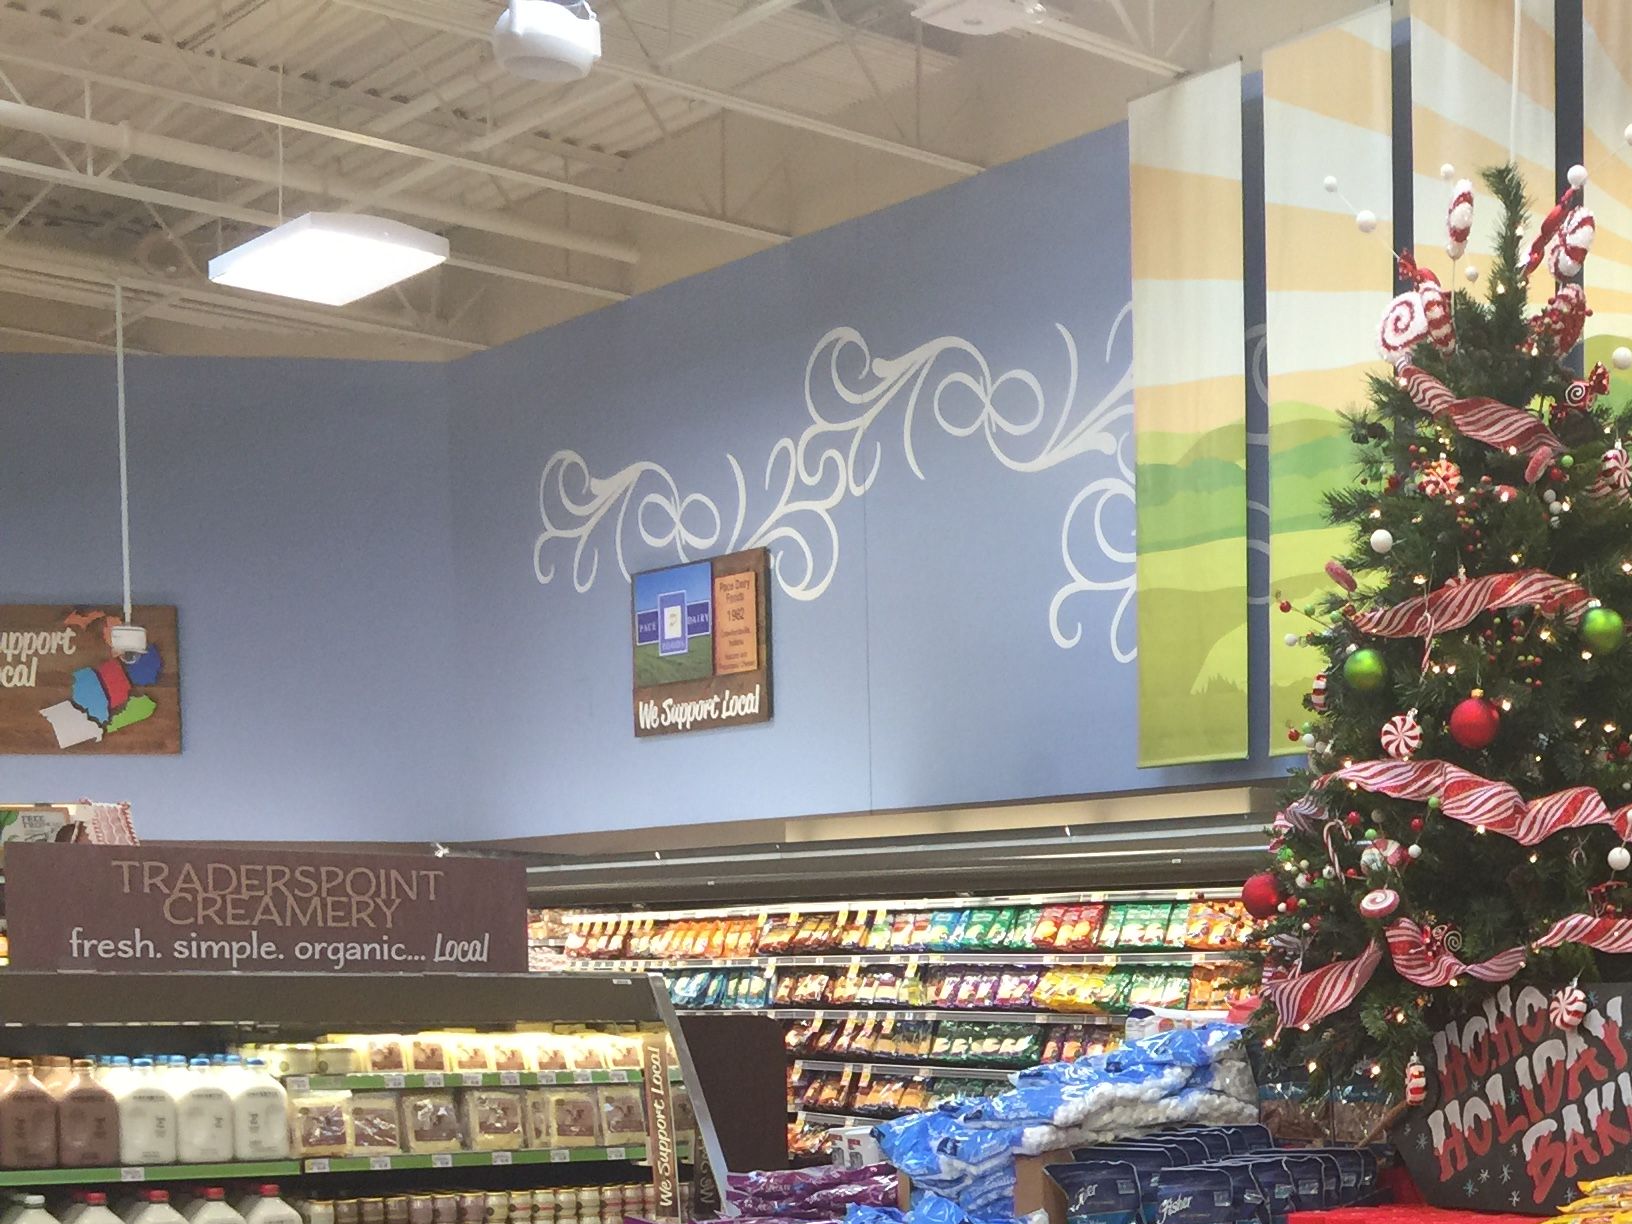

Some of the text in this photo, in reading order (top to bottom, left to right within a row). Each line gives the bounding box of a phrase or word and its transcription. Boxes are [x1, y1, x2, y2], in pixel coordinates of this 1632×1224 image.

[0, 656, 38, 688] cal
[639, 684, 760, 730] We Support Local
[111, 859, 445, 901] TRADERSPOINT
[162, 892, 402, 928] CREAMERY
[69, 927, 162, 960] fresh.
[173, 930, 284, 970] simple.
[432, 932, 490, 963] Local
[1427, 995, 1629, 1183] HOLIDAY
[647, 1046, 673, 1207] We Support Local
